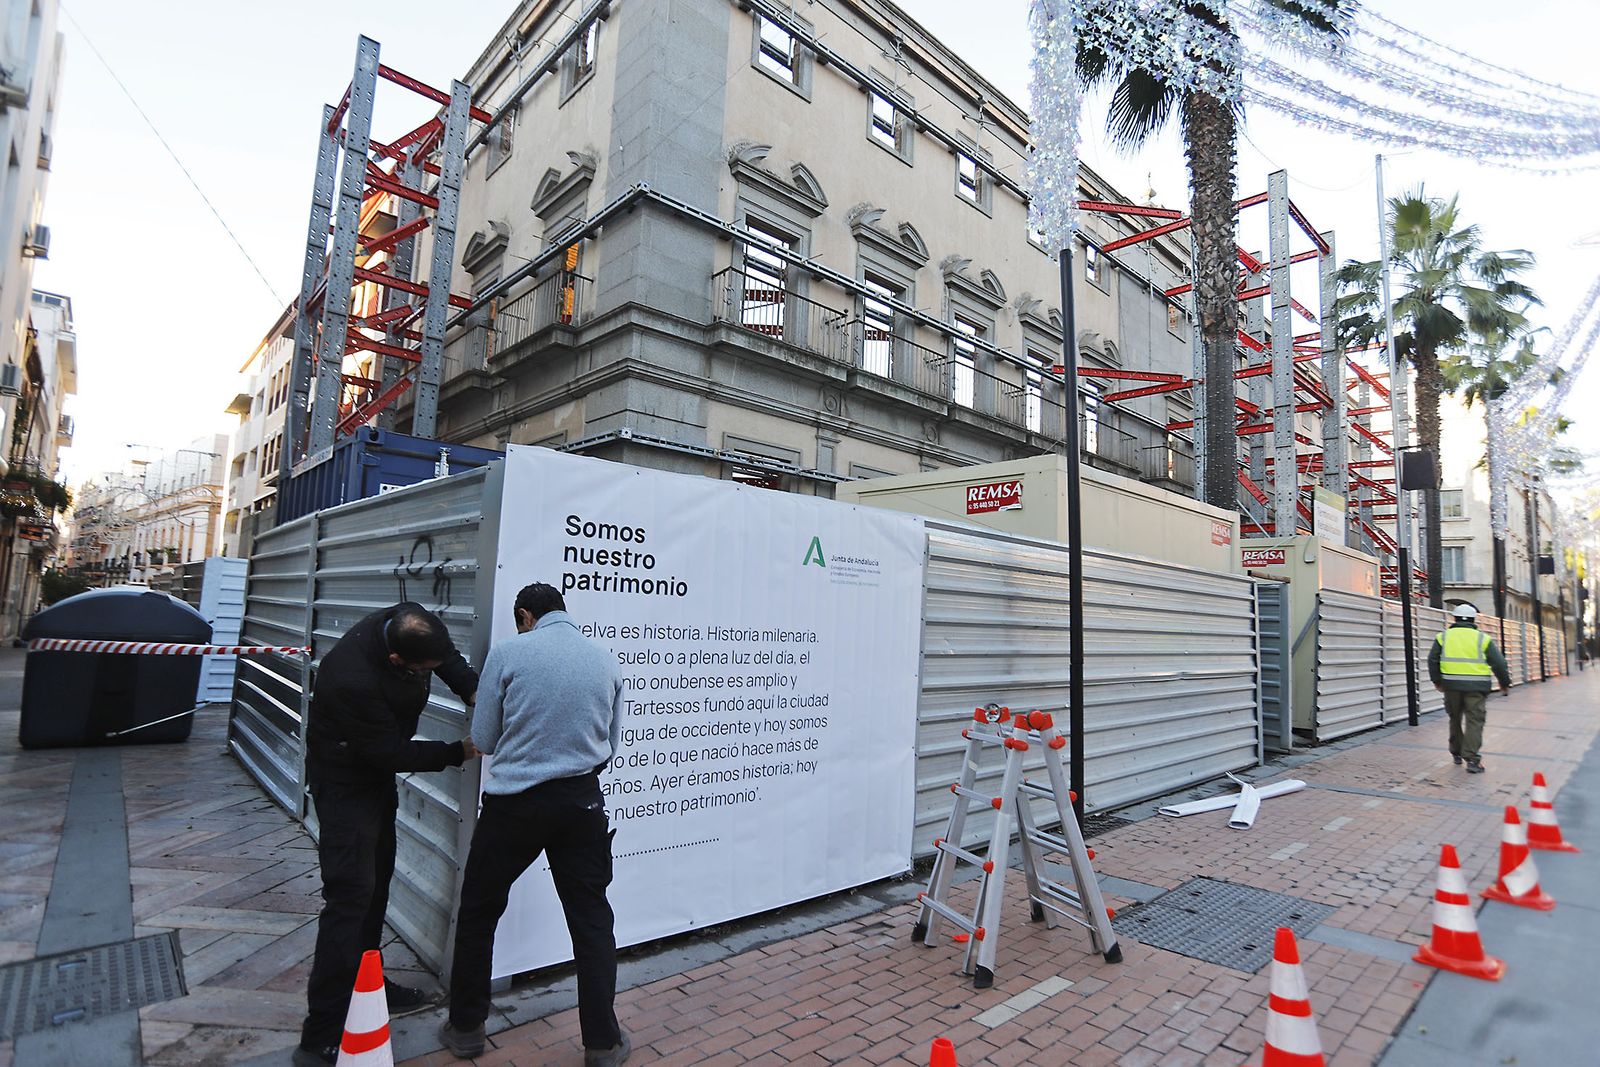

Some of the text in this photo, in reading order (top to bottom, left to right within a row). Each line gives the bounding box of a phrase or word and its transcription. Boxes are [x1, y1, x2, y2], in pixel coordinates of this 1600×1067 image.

[968, 483, 1021, 501] REMSA
[565, 515, 645, 543] Somos
[564, 546, 655, 569] nuestro
[1243, 551, 1284, 560] REMSA
[562, 571, 687, 597] patrimonio
[579, 622, 819, 643] elva es historia. Historia milenaria.
[618, 649, 660, 664] suelo
[664, 653, 674, 664] o
[677, 653, 686, 664] a
[690, 650, 728, 669] plena
[732, 650, 750, 664] luz
[754, 650, 773, 664] del
[800, 651, 810, 664] el
[650, 674, 724, 690] onubense
[727, 676, 743, 688] es
[746, 673, 787, 691] amplio
[790, 676, 797, 690] y
[624, 693, 829, 715] Tartessos fundó aquí la ciudad
[621, 717, 827, 746] igua de occidente y hoy somos
[629, 751, 648, 767] de
[653, 750, 666, 765] lo
[670, 750, 698, 767] que
[702, 742, 739, 760] nació
[742, 743, 773, 756] hace
[776, 738, 801, 753] más
[804, 737, 818, 750] de
[602, 779, 645, 796] años.
[650, 775, 684, 794] Ayer
[687, 769, 739, 786] éramos
[796, 760, 818, 774] hoy
[615, 800, 677, 820] nuestro
